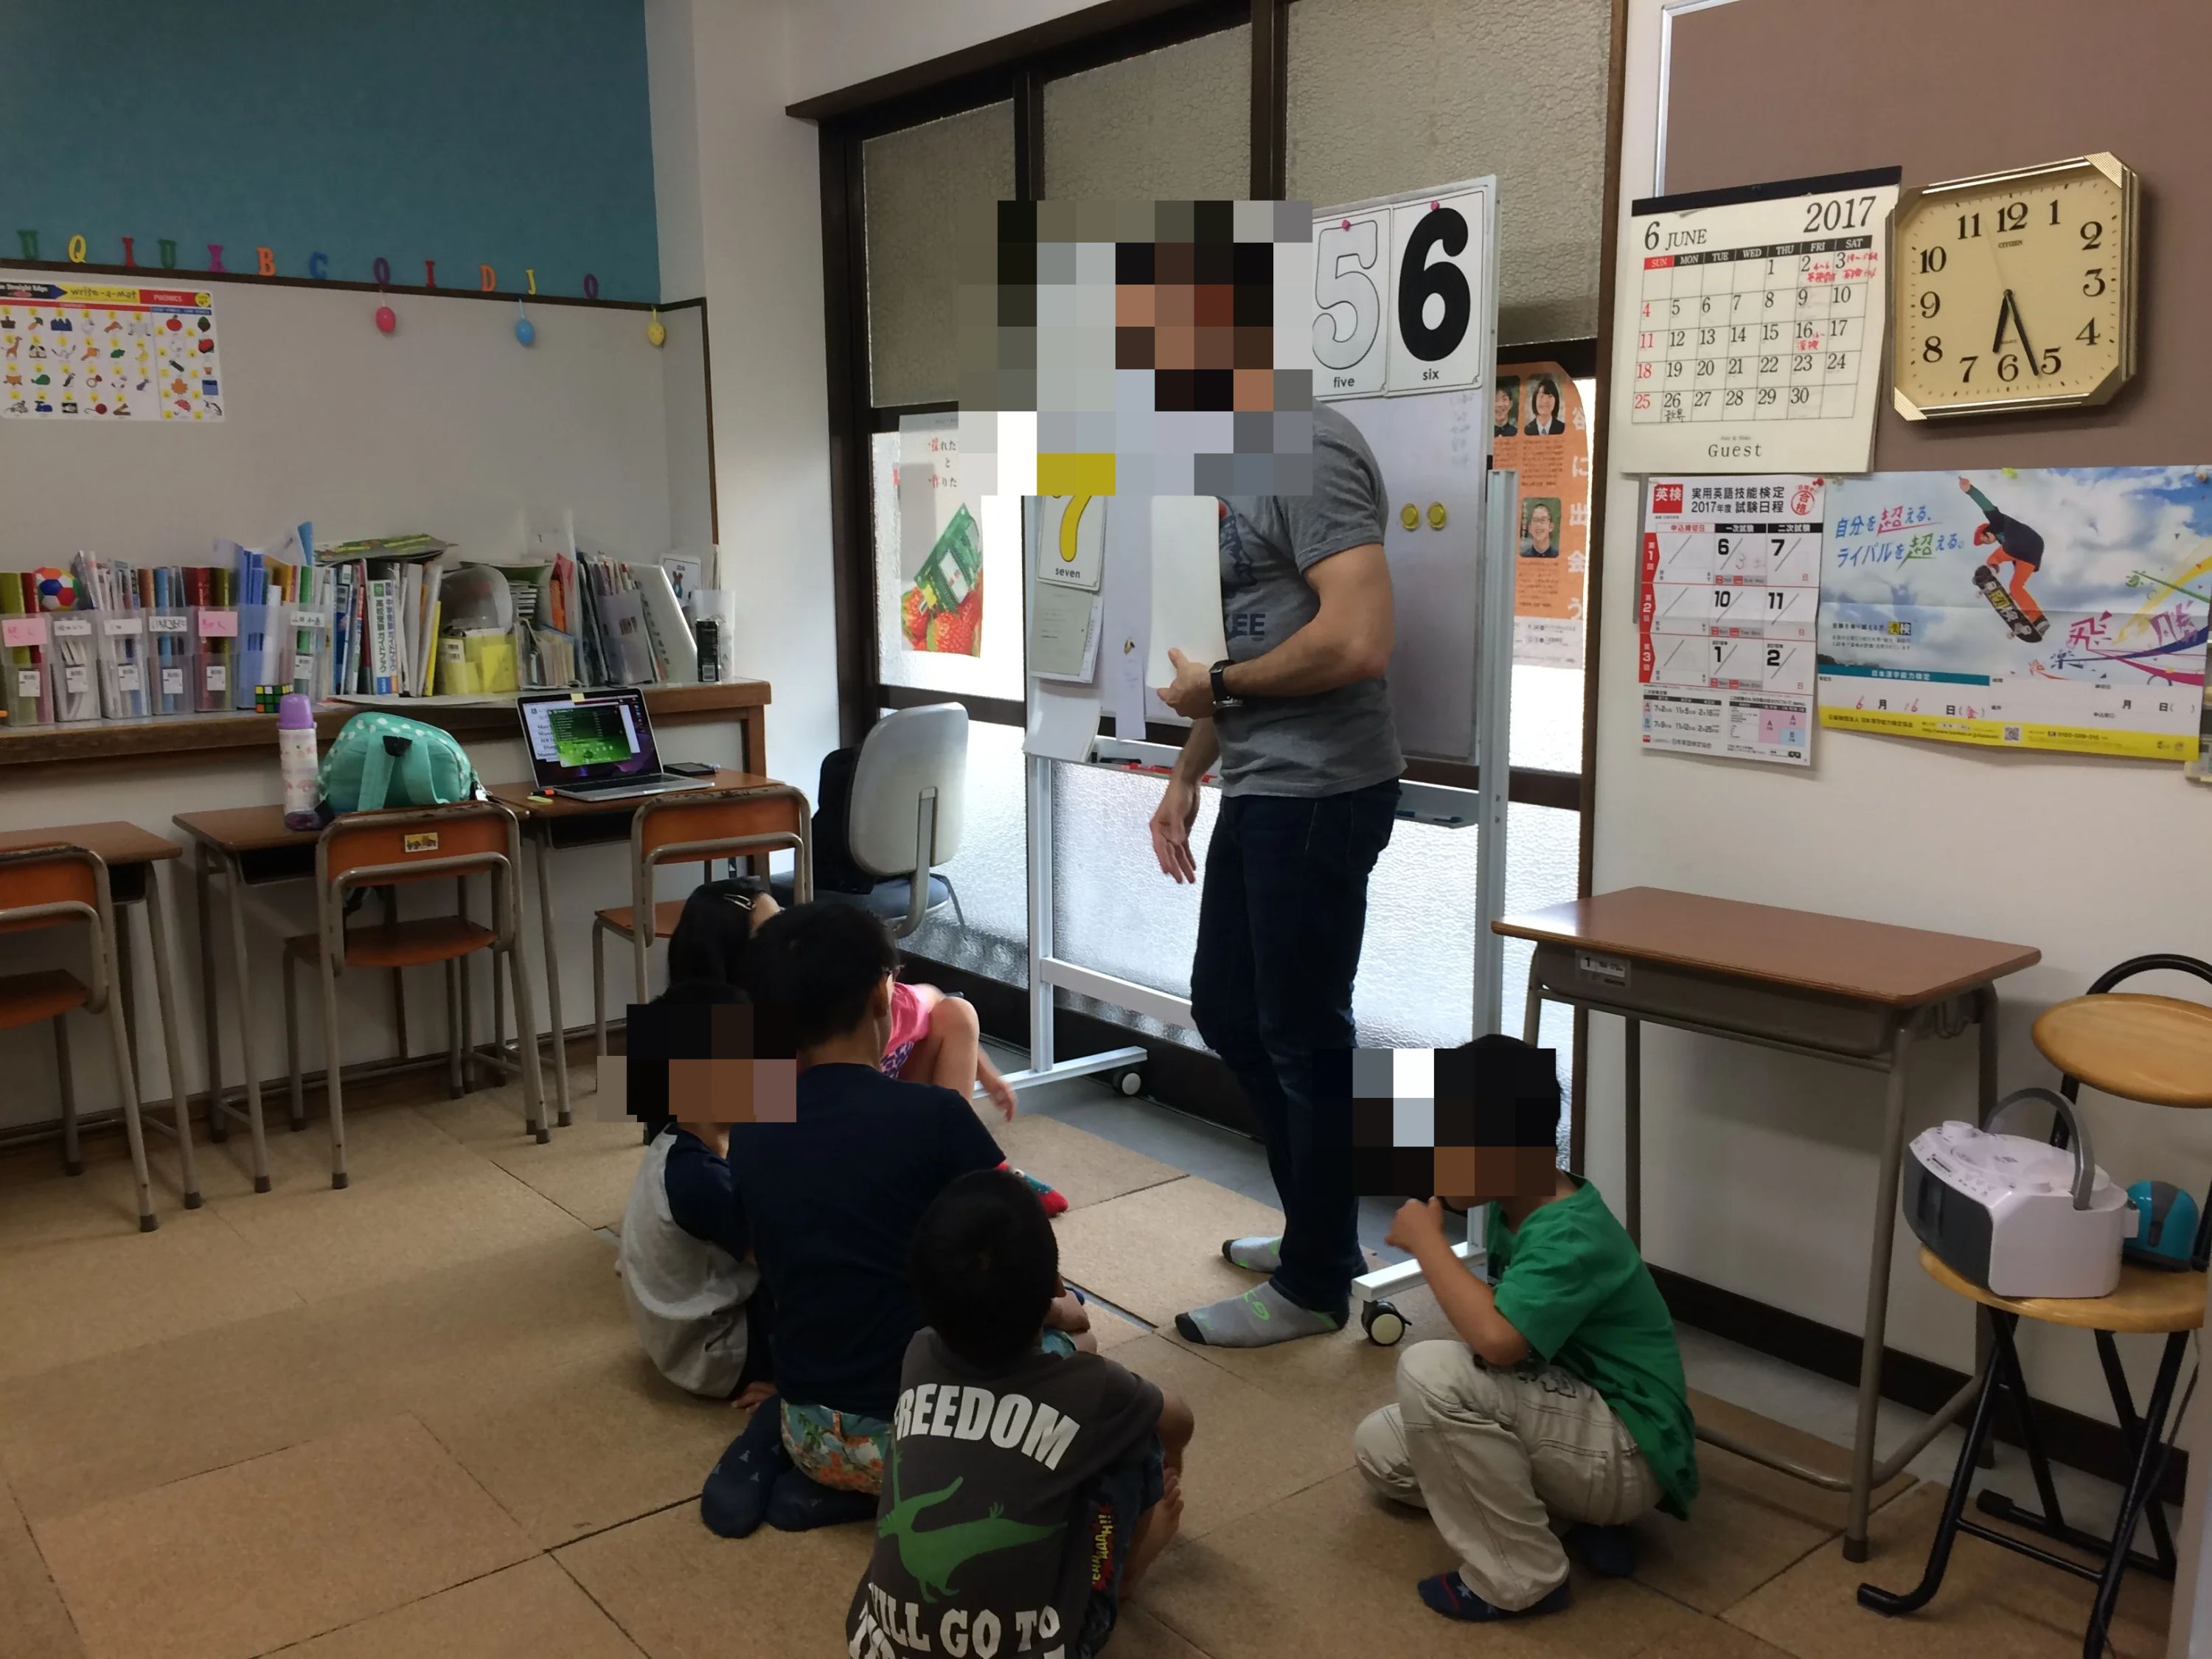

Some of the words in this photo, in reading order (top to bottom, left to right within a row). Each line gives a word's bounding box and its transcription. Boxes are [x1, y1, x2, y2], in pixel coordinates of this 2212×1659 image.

[1644, 221, 1660, 250] 6
[1665, 229, 1707, 251] JUNE
[1804, 195, 1877, 233] 2017
[1997, 202, 2028, 232] 12
[2049, 200, 2060, 226] 1
[1958, 212, 1981, 239] 11
[2080, 221, 2102, 250] 2
[68, 234, 86, 263] Q
[158, 239, 177, 269] U
[257, 247, 276, 276] B
[309, 251, 328, 279] C
[425, 260, 437, 287] I
[479, 265, 496, 291] D
[526, 269, 537, 294] J
[1652, 259, 1667, 267] SUN
[1680, 255, 1698, 265] MON
[1712, 252, 1728, 261] TUE
[1743, 248, 1761, 258] WED
[1776, 245, 1794, 254] THU
[1810, 241, 1826, 251] FRI
[1846, 238, 1863, 248] SAT
[1768, 259, 1775, 275] 1
[1801, 256, 1810, 272] 2
[1835, 252, 1846, 268] 3
[1920, 246, 1947, 274] 10
[1312, 220, 1380, 370] 5
[1398, 207, 1471, 362] 6
[2083, 268, 2105, 296] 3
[153, 293, 183, 302] PHONICS
[1642, 302, 1650, 317] 4
[1672, 299, 1680, 315] 5
[1702, 297, 1711, 313] 6
[1733, 294, 1742, 310] 7
[1764, 291, 1774, 307] 8
[1798, 289, 1807, 305] 9
[1832, 286, 1851, 302] 10
[1920, 291, 1940, 319] 9
[1641, 333, 1654, 348] 11
[1669, 331, 1685, 347] 12
[1700, 329, 1715, 344] 13
[1731, 327, 1746, 342] 14
[1762, 324, 1778, 340] 15
[1795, 321, 1812, 338] 16
[1830, 320, 1848, 336] 17
[2075, 318, 2101, 346] 4
[1923, 336, 1943, 363] 8
[2041, 347, 2061, 375] 5
[1637, 363, 1652, 378] 18
[1666, 361, 1683, 378] 19
[1697, 360, 1714, 375] 20
[1728, 358, 1743, 374] 21
[1760, 356, 1778, 373] 22
[1793, 355, 1812, 372] 23
[1827, 353, 1846, 369] 24
[1959, 355, 1978, 383] 7
[1997, 354, 2019, 381] 6
[1333, 375, 1355, 389] five
[1422, 369, 1440, 380] six
[1635, 394, 1650, 409] 25
[1663, 392, 1680, 408] 26
[1694, 392, 1711, 407] 27
[1725, 390, 1744, 406] 28
[1758, 389, 1776, 405] 29
[1790, 387, 1809, 403] 30
[1708, 444, 1762, 457] Guest
[1655, 487, 1682, 501] 英検
[1691, 487, 1784, 499] 実用英語技能検定
[1795, 493, 1810, 513] 合格
[1691, 501, 1731, 513] 2017年度
[1735, 501, 1784, 513] 試験日程
[1725, 524, 1754, 532] 一次試験
[1778, 524, 1811, 532] 二次試験
[1718, 538, 1729, 554] 6
[1771, 539, 1784, 556] 7
[1054, 566, 1081, 579] seven
[1714, 591, 1731, 607] 10
[1769, 593, 1784, 609] 11
[1714, 647, 1721, 662] 1
[1767, 650, 1780, 666] 2
[1871, 669, 1930, 681] 日本漢字能力検定
[1856, 696, 1864, 710] 6
[1878, 699, 1887, 710] 月
[1947, 705, 1955, 715] 日
[2123, 700, 2132, 709] 月
[1585, 957, 1590, 967] 1
[940, 1608, 1001, 1659] GO
[1015, 1605, 1060, 1652] TO
